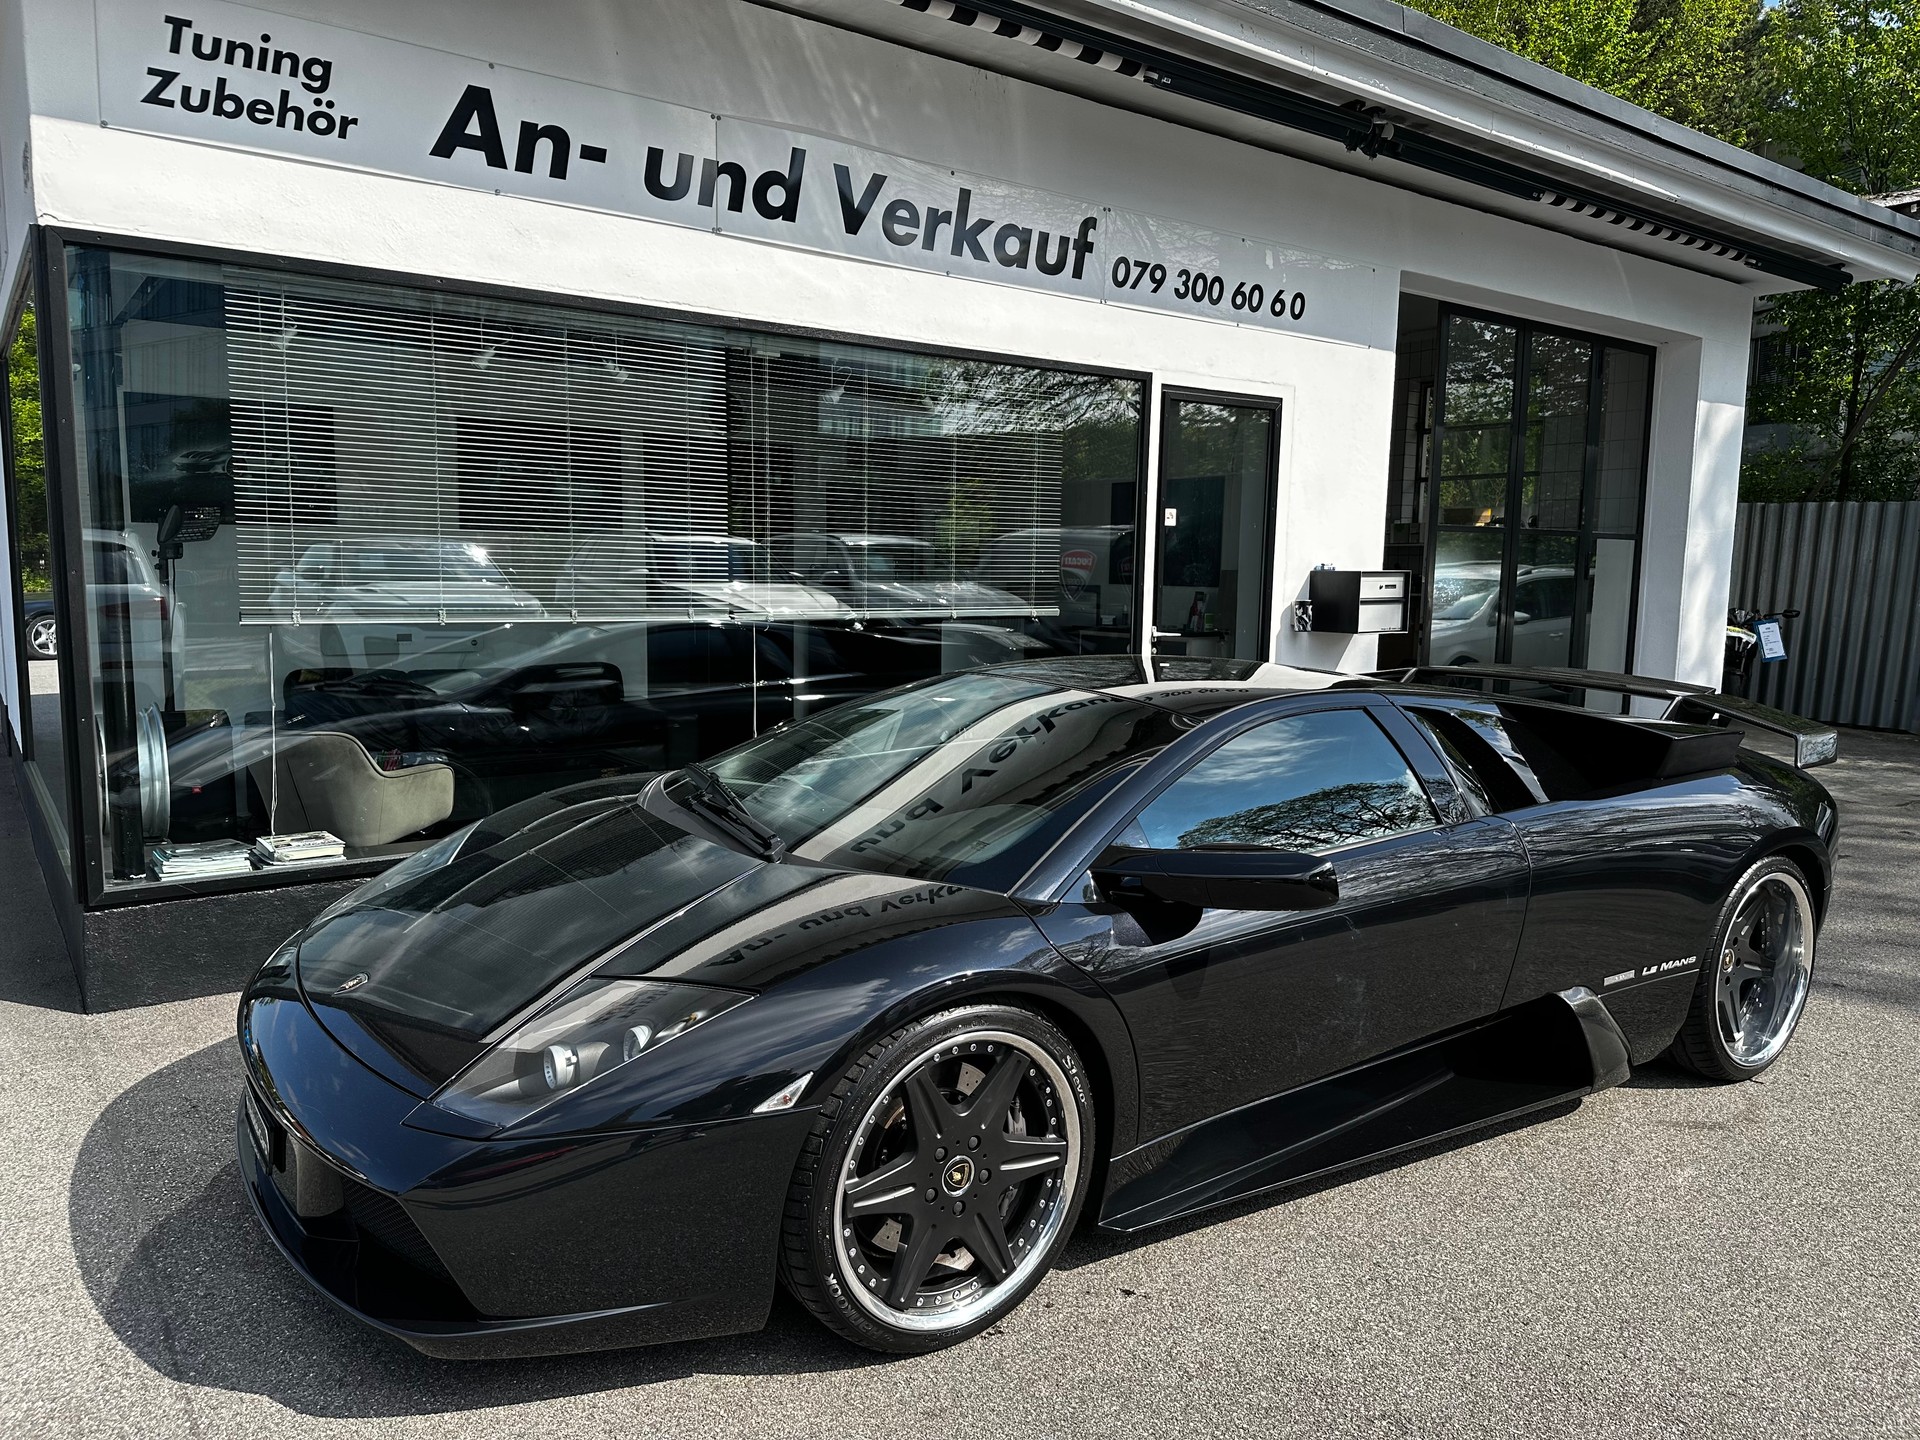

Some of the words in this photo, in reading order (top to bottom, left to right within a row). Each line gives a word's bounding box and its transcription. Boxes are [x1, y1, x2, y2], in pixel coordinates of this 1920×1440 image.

[164, 15, 333, 94] Tuning
[140, 66, 358, 140] Zubehör
[428, 84, 608, 181] An-
[642, 146, 806, 223] und
[833, 162, 1098, 280] Verkauf
[1112, 256, 1167, 294] 079
[1174, 269, 1225, 306] 300
[1231, 281, 1264, 313] 60
[1269, 289, 1306, 320] 60
[1660, 955, 1697, 971] MANS
